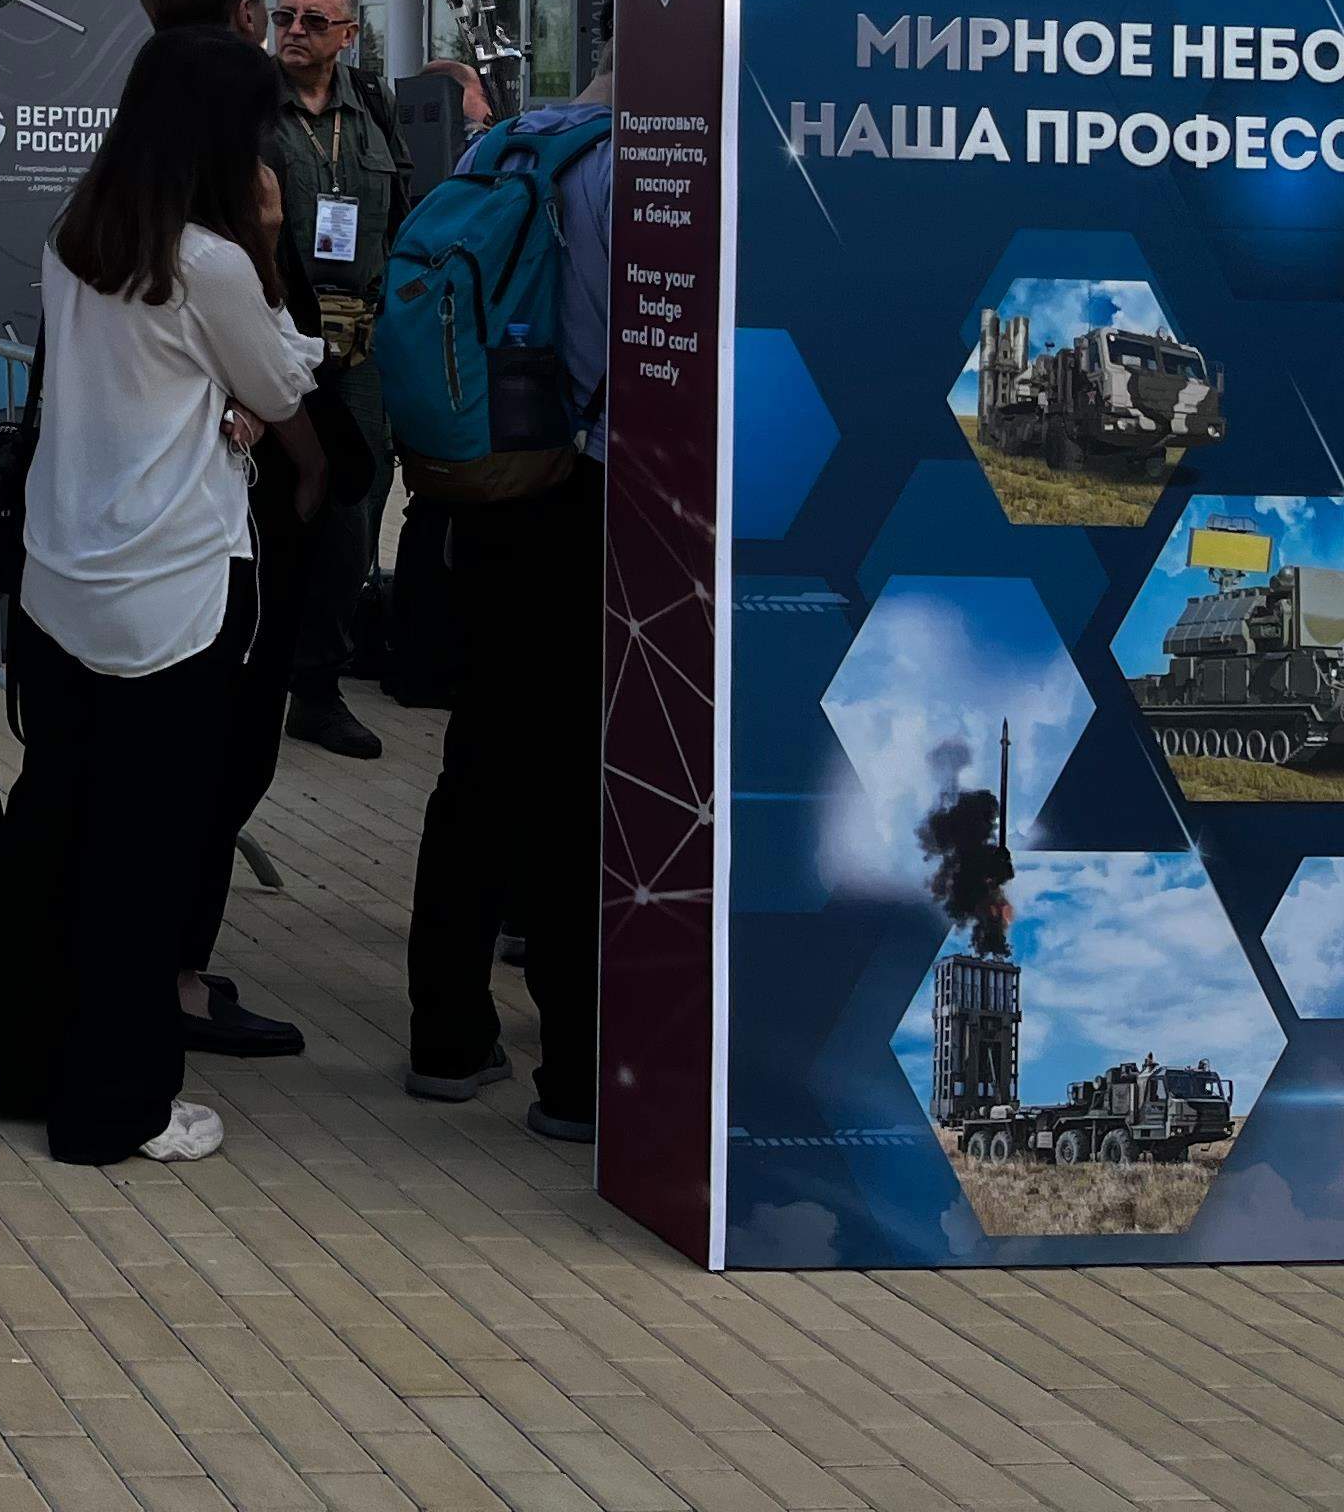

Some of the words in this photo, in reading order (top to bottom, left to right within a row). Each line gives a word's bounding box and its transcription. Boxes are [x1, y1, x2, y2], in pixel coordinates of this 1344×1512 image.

[856, 13, 1153, 77] МИРНОЕ
[1172, 23, 1344, 83] НЕБО
[620, 111, 709, 135] Подготовьте,
[789, 101, 1011, 163] НАША
[620, 144, 708, 166] пожалуйста,
[635, 177, 691, 198] паспорт
[634, 208, 642, 222] и
[646, 203, 692, 228] бейдж
[627, 263, 661, 285] Have
[665, 271, 696, 291] your
[639, 294, 682, 323] badge
[622, 327, 648, 346] and
[651, 327, 666, 348] ID
[668, 333, 697, 352] card
[639, 360, 680, 387] ready
